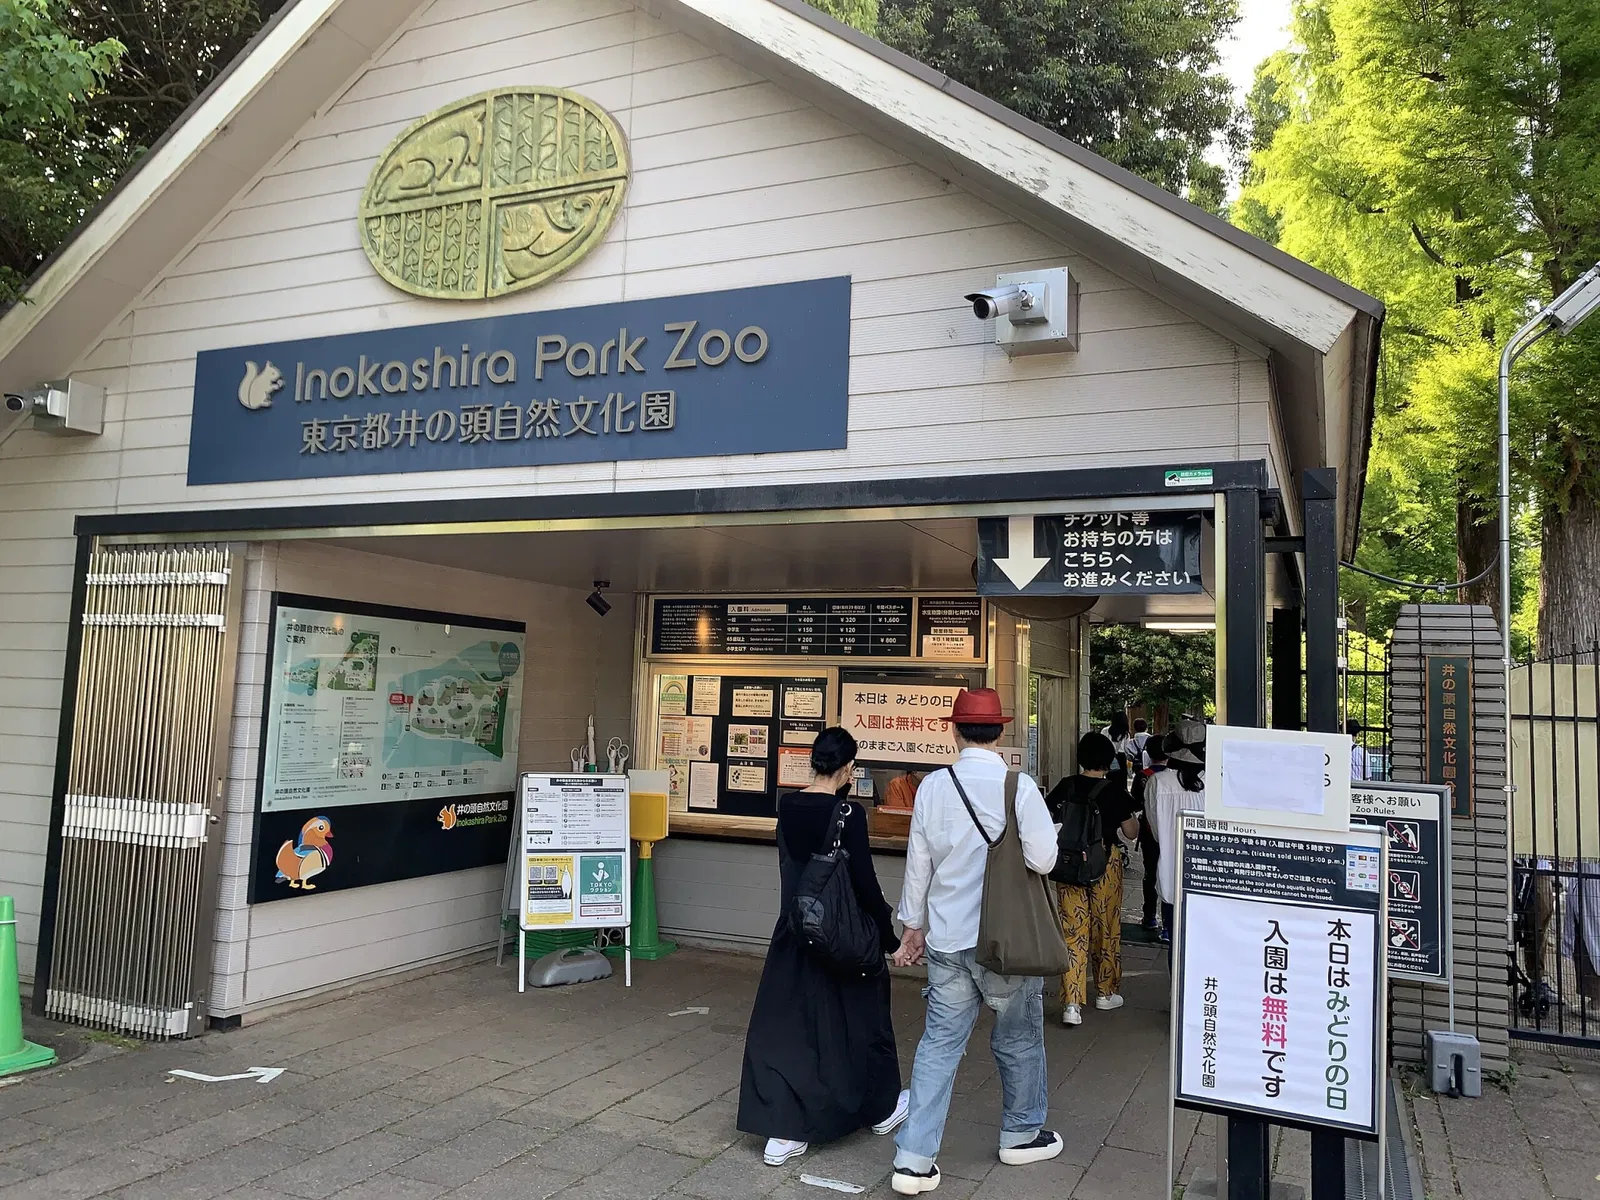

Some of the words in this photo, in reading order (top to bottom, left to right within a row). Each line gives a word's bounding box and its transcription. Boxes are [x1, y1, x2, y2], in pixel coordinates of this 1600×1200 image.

[294, 349, 517, 402] Inokashira
[536, 327, 648, 378] Park
[663, 320, 768, 370] Zoo
[299, 390, 677, 455] 東京都井の頭自然文化園
[1064, 529, 1172, 548] お持ちの方は
[1064, 552, 1133, 567] こちらへ
[1064, 571, 1191, 588] お進みください
[286, 635, 306, 644] ご案内
[854, 692, 888, 705] 本日は
[895, 694, 953, 708] みどりの日
[854, 714, 950, 732] 入園は無料です
[457, 800, 509, 815] 井の頭自然文化園
[1373, 807, 1396, 815] Rules
[456, 817, 485, 827] Inokashira
[485, 815, 498, 824] Park
[498, 814, 507, 822] Zoo
[1186, 818, 1228, 831] 開園時間
[1233, 826, 1257, 834] Hours
[1251, 850, 1276, 858] (tickets
[1293, 854, 1309, 862] until
[1327, 858, 1345, 866] p.m.)
[1191, 873, 1208, 881] Tickets
[1211, 883, 1252, 893] non-refundable,
[1261, 919, 1289, 1098] 入園は無料です
[1325, 918, 1351, 1110] 本日はみどりの日
[1202, 976, 1218, 1088] 井の頭自然文化園
